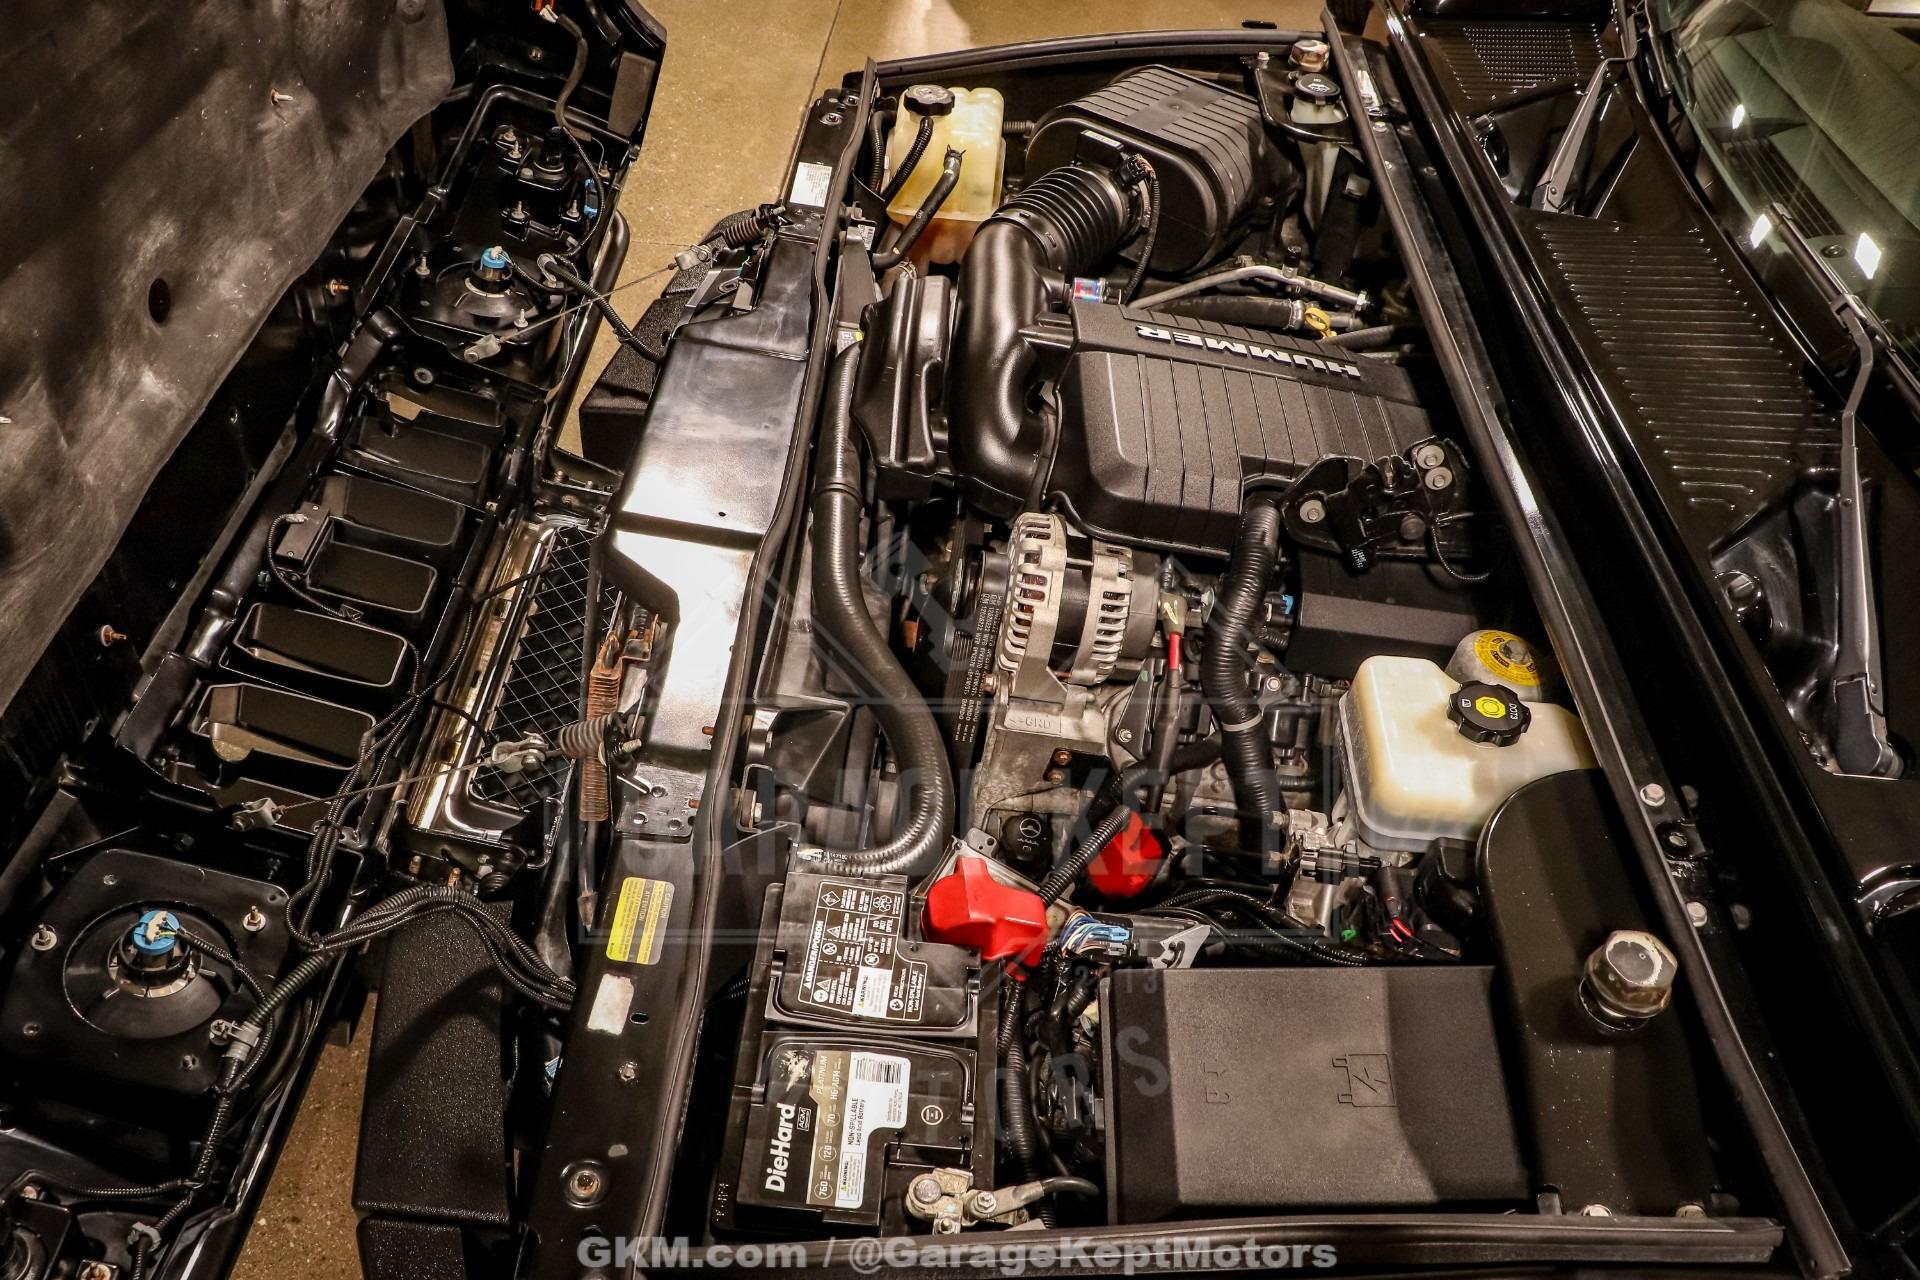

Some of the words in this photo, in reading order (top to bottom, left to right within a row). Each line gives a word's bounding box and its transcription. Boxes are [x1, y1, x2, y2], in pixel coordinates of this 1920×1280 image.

[1136, 325, 1361, 378] HUMMER
[638, 890, 651, 921] ATTENTION
[660, 893, 672, 919] CAUTION
[805, 920, 825, 982] DANGER/POISON
[907, 970, 918, 1013] NON-SPILLABLE
[817, 1055, 828, 1095] PLATINUM
[831, 1070, 840, 1100] H6-AGM
[799, 1108, 807, 1128] AGM
[827, 1113, 836, 1124] 70
[848, 1098, 858, 1145] NON-SPILLABLE
[857, 1098, 865, 1120] Battery
[765, 1102, 796, 1193] DieHard
[823, 1145, 832, 1158] 120
[819, 1181, 828, 1196] 760
